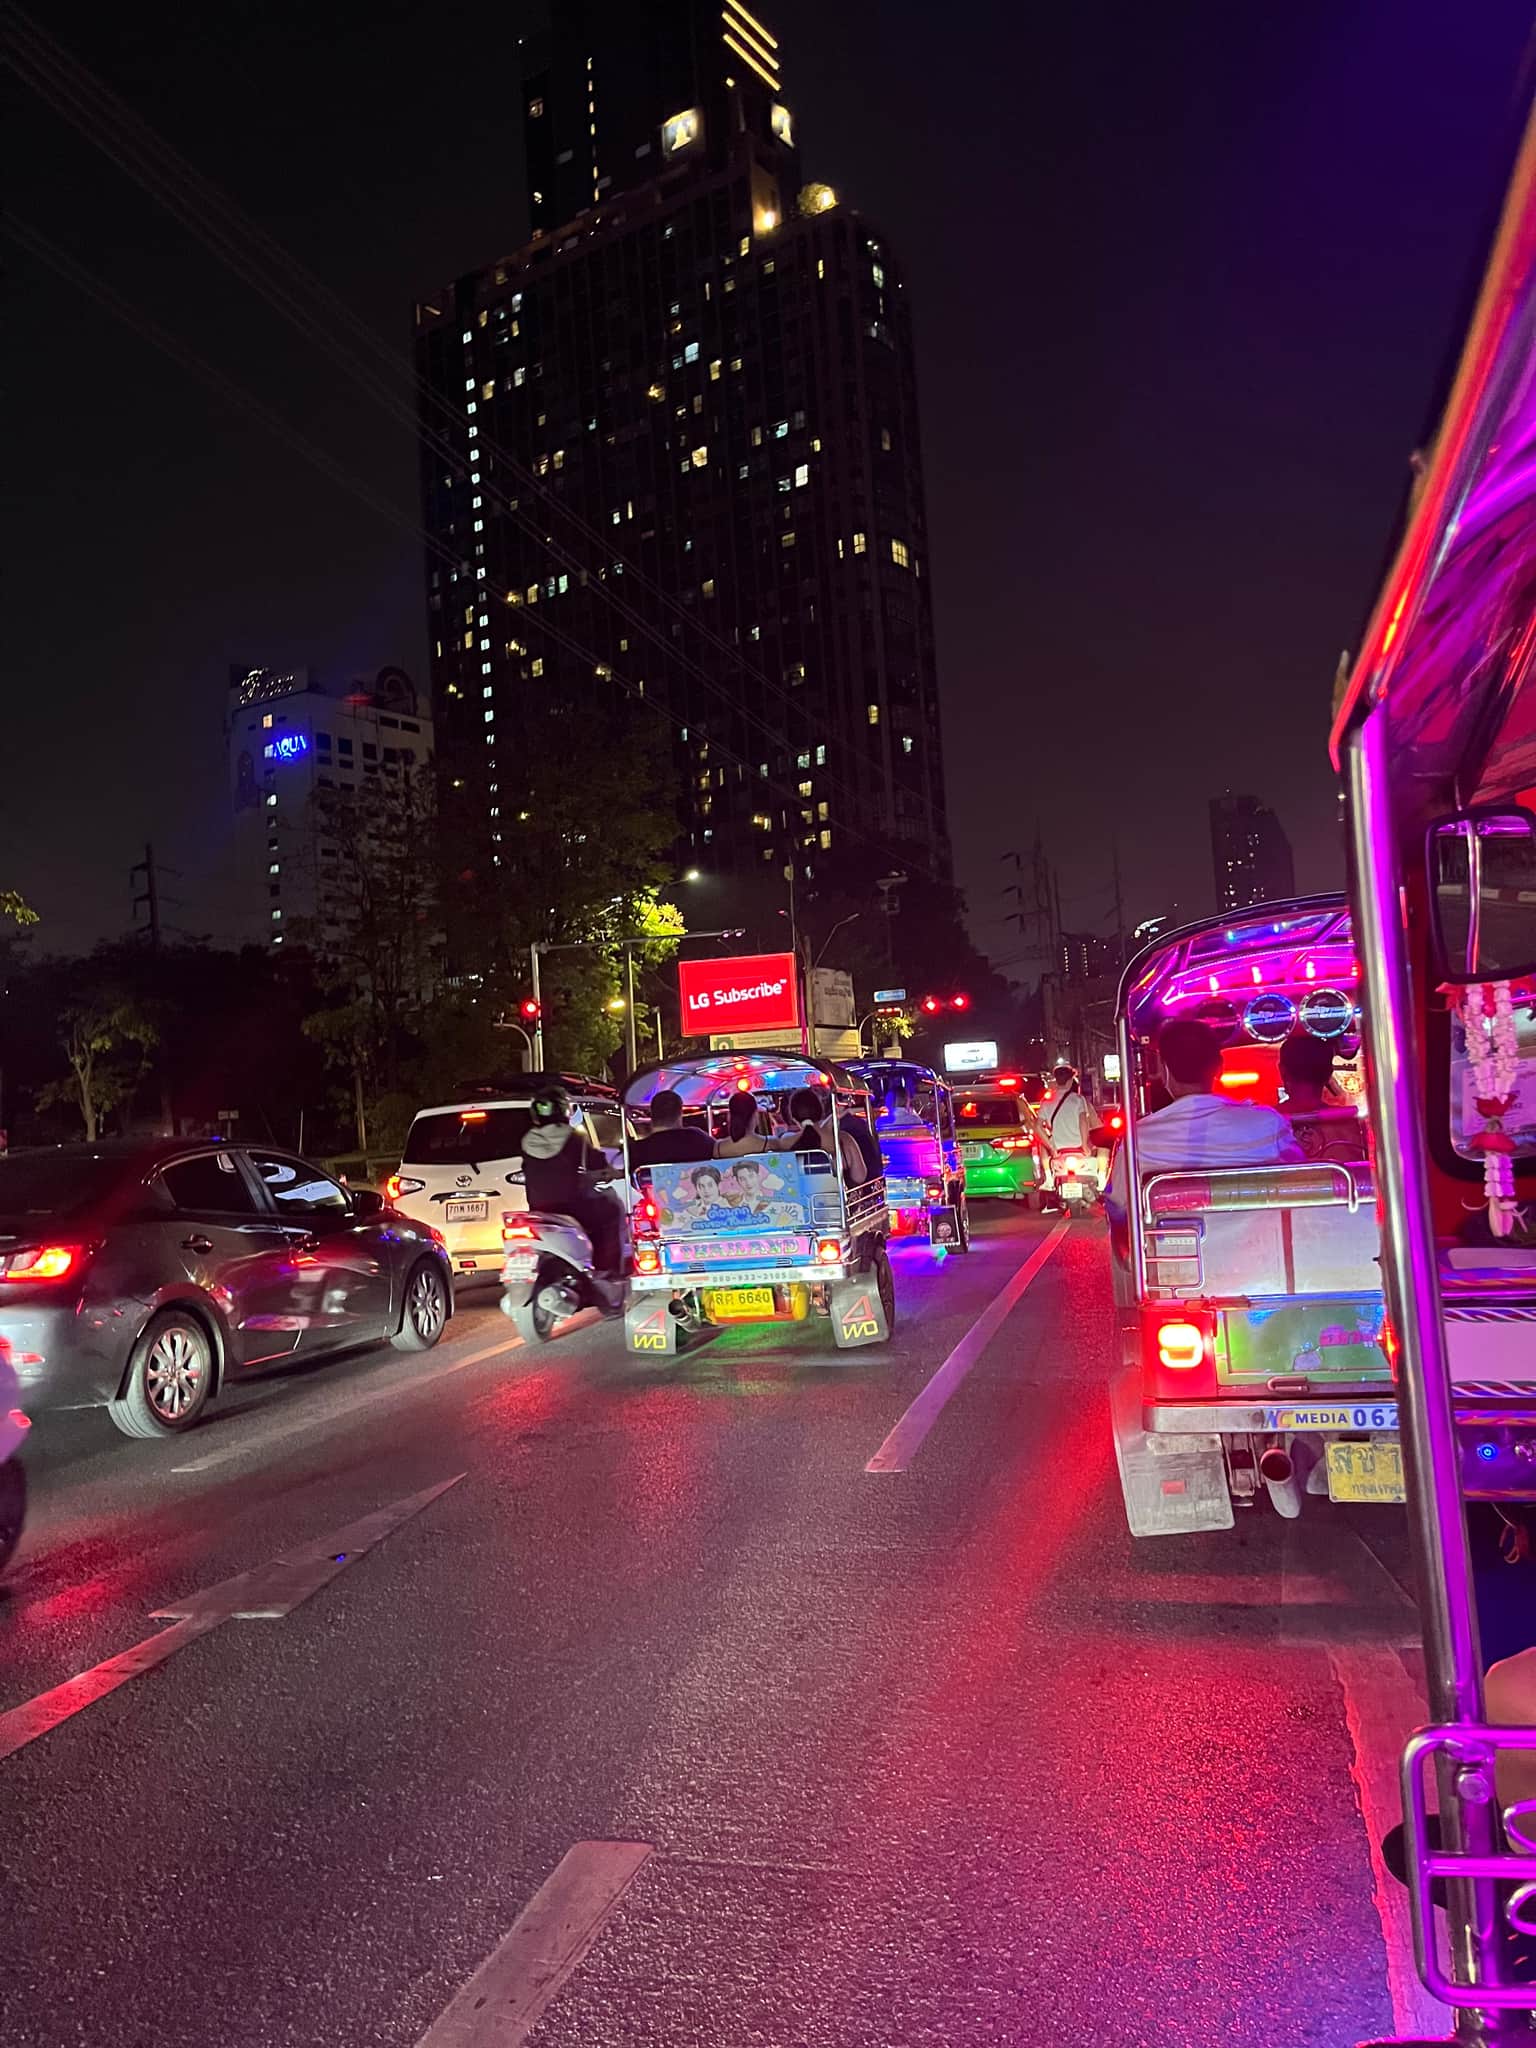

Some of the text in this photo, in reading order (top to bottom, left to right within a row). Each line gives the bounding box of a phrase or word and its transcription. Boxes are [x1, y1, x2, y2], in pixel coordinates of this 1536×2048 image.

[273, 735, 307, 760] AQUA
[689, 993, 710, 1011] LG
[680, 1238, 800, 1259] THAILAND
[738, 1290, 770, 1304] 6640
[1295, 1412, 1348, 1424] MEDIA
